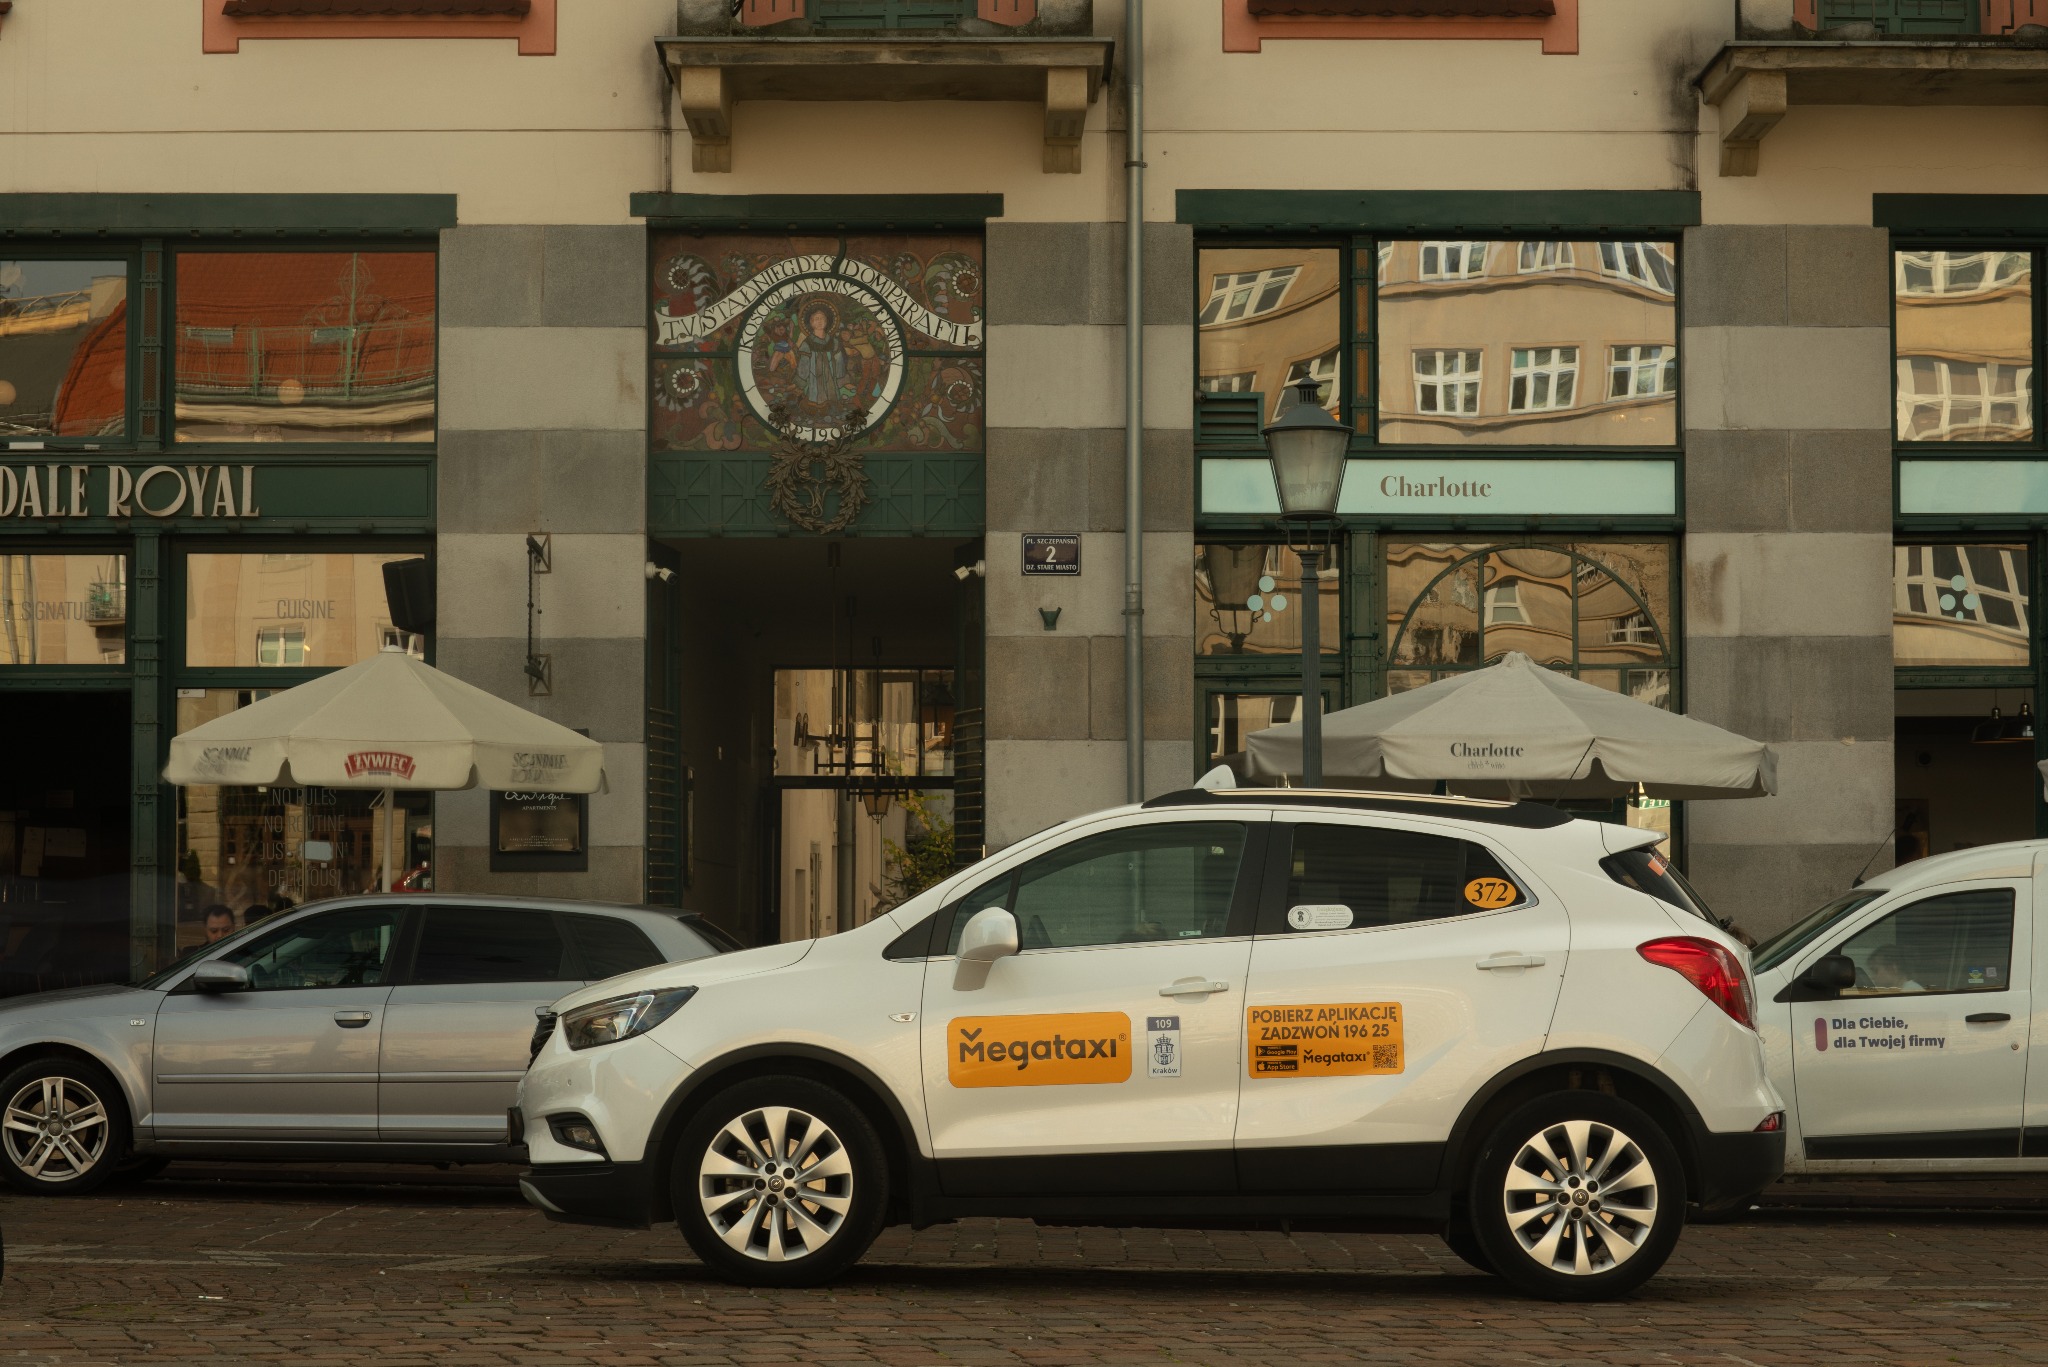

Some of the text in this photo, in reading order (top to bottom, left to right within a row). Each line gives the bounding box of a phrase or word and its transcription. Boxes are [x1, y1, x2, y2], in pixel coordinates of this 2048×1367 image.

[842, 259, 889, 295] DOM
[107, 464, 260, 517] ROYAL
[1380, 475, 1493, 498] Charlotte
[1045, 545, 1057, 563] 2
[276, 599, 336, 620] CUISINE
[1450, 742, 1524, 758] Charlotte
[272, 788, 337, 806] NO RULES
[264, 814, 345, 833] NO ROUTINE
[1471, 882, 1508, 902] 372
[1155, 1019, 1172, 1029] 109
[1252, 1006, 1398, 1024] POBIERZ APLIKACJĘ
[1832, 1016, 1909, 1030] Dla Ciebie,
[1261, 1021, 1390, 1040] ZADZWOŃ 196 25
[1833, 1034, 1946, 1050] dla Twojej firmy
[1152, 1067, 1178, 1075] Kraków
